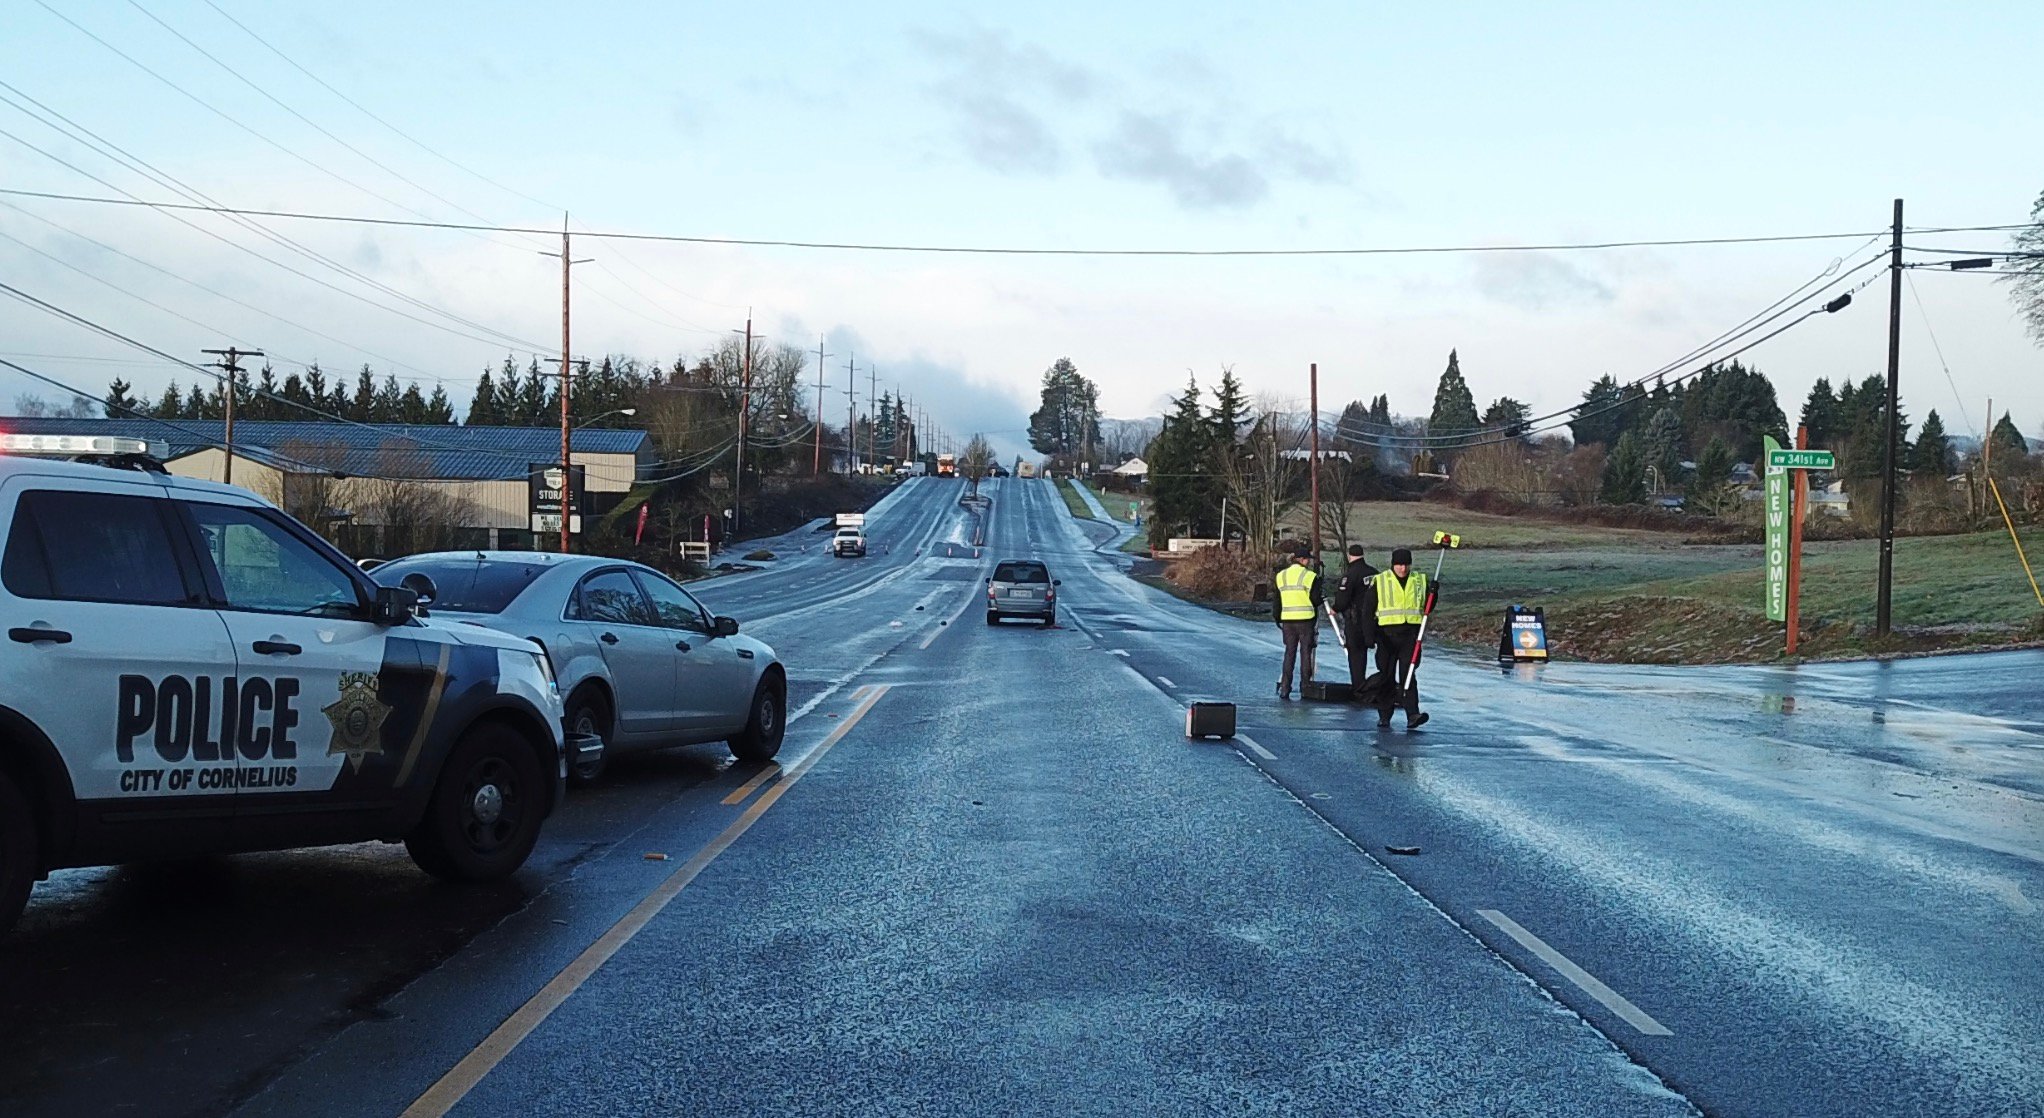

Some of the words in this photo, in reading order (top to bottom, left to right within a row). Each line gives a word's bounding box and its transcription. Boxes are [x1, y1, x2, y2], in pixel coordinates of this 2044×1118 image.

[1774, 455, 1786, 464] NW
[1787, 453, 1813, 465] 341st
[1816, 456, 1829, 465] Ave
[539, 490, 573, 500] STORAE
[1769, 479, 1782, 527] NEW
[1769, 533, 1783, 614] HOMES
[338, 672, 379, 695] SHERIFF
[116, 674, 300, 764] POLICE
[120, 769, 165, 793] CITY
[168, 769, 194, 792] OF
[198, 766, 298, 789] CORNELIUS
